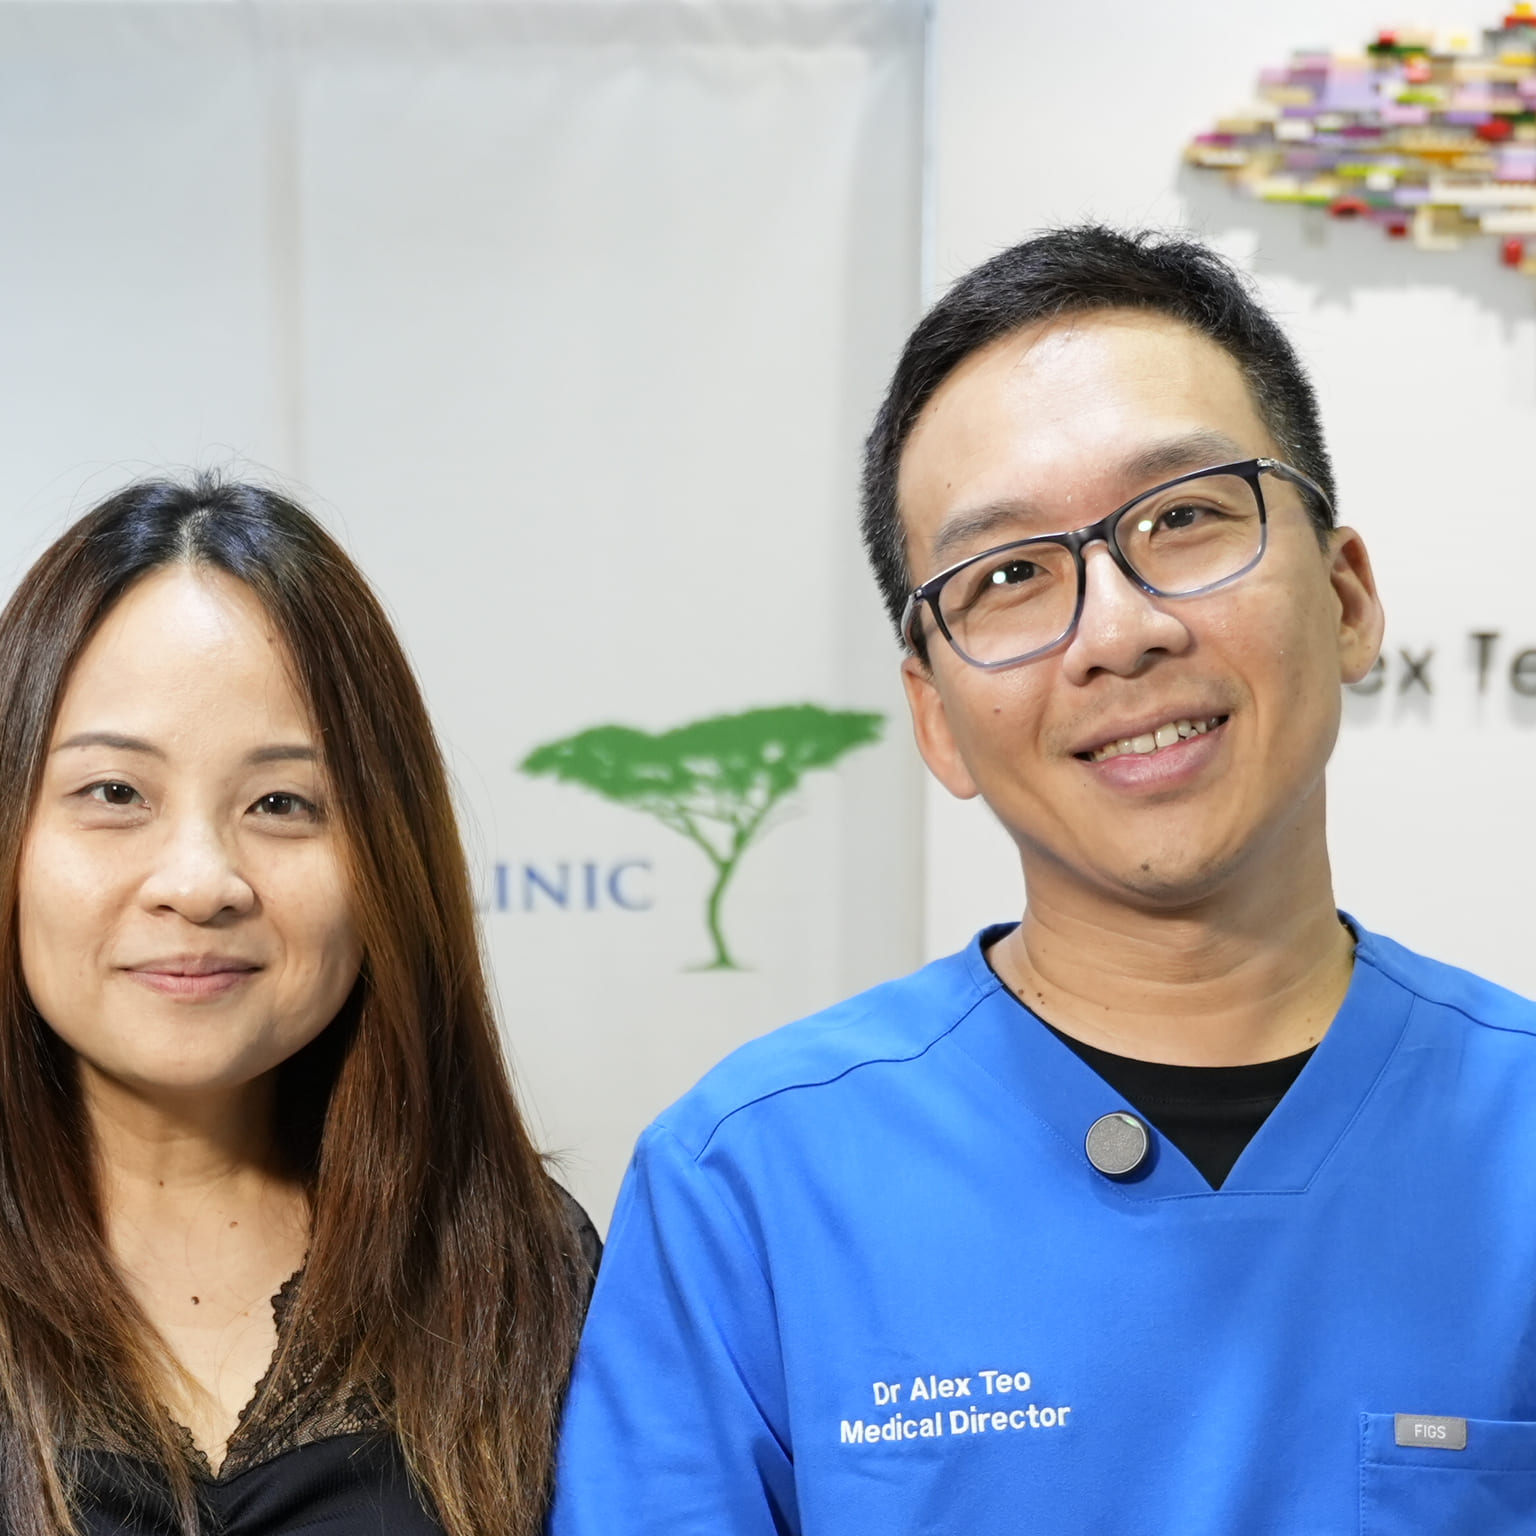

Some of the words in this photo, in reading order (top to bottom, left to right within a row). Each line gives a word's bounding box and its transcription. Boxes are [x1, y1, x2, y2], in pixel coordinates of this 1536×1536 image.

[872, 1382, 901, 1406] Dr
[910, 1375, 972, 1401] Alex
[978, 1370, 1031, 1394] Teo
[840, 1412, 943, 1444] Medical
[949, 1404, 1072, 1435] Director
[1414, 1424, 1447, 1440] FIGS
